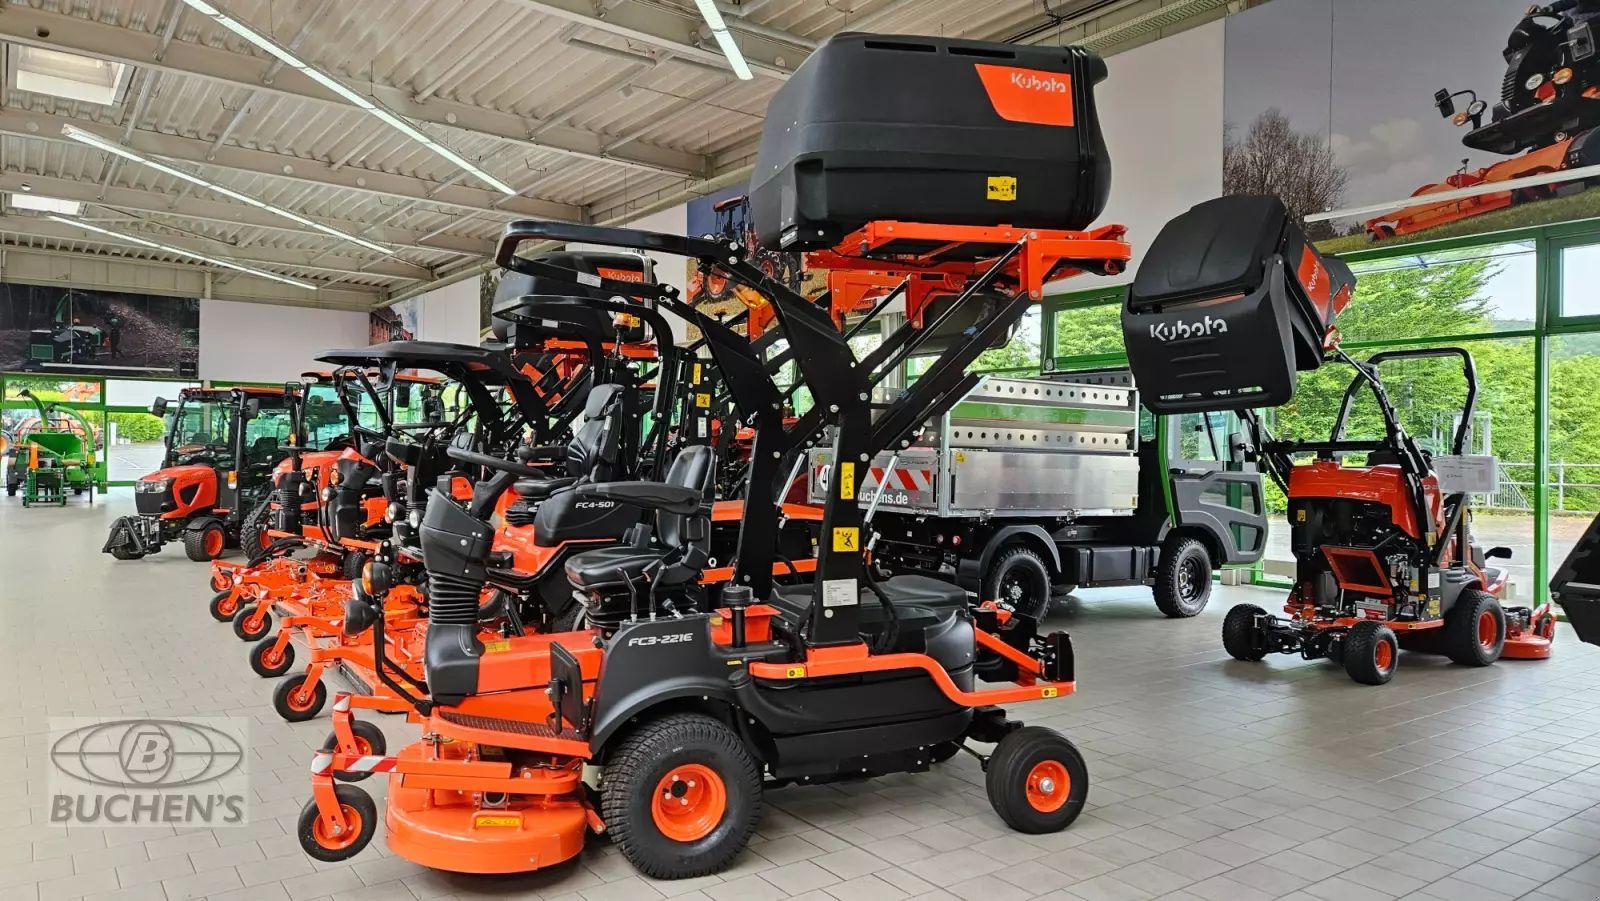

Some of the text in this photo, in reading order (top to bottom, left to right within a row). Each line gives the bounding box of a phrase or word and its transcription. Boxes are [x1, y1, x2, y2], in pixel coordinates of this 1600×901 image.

[1011, 72, 1066, 93] Kubota
[607, 271, 641, 283] Kubota
[1150, 315, 1228, 342] Kubota
[575, 501, 615, 509] FC4-501
[628, 632, 694, 647] FC3-221E
